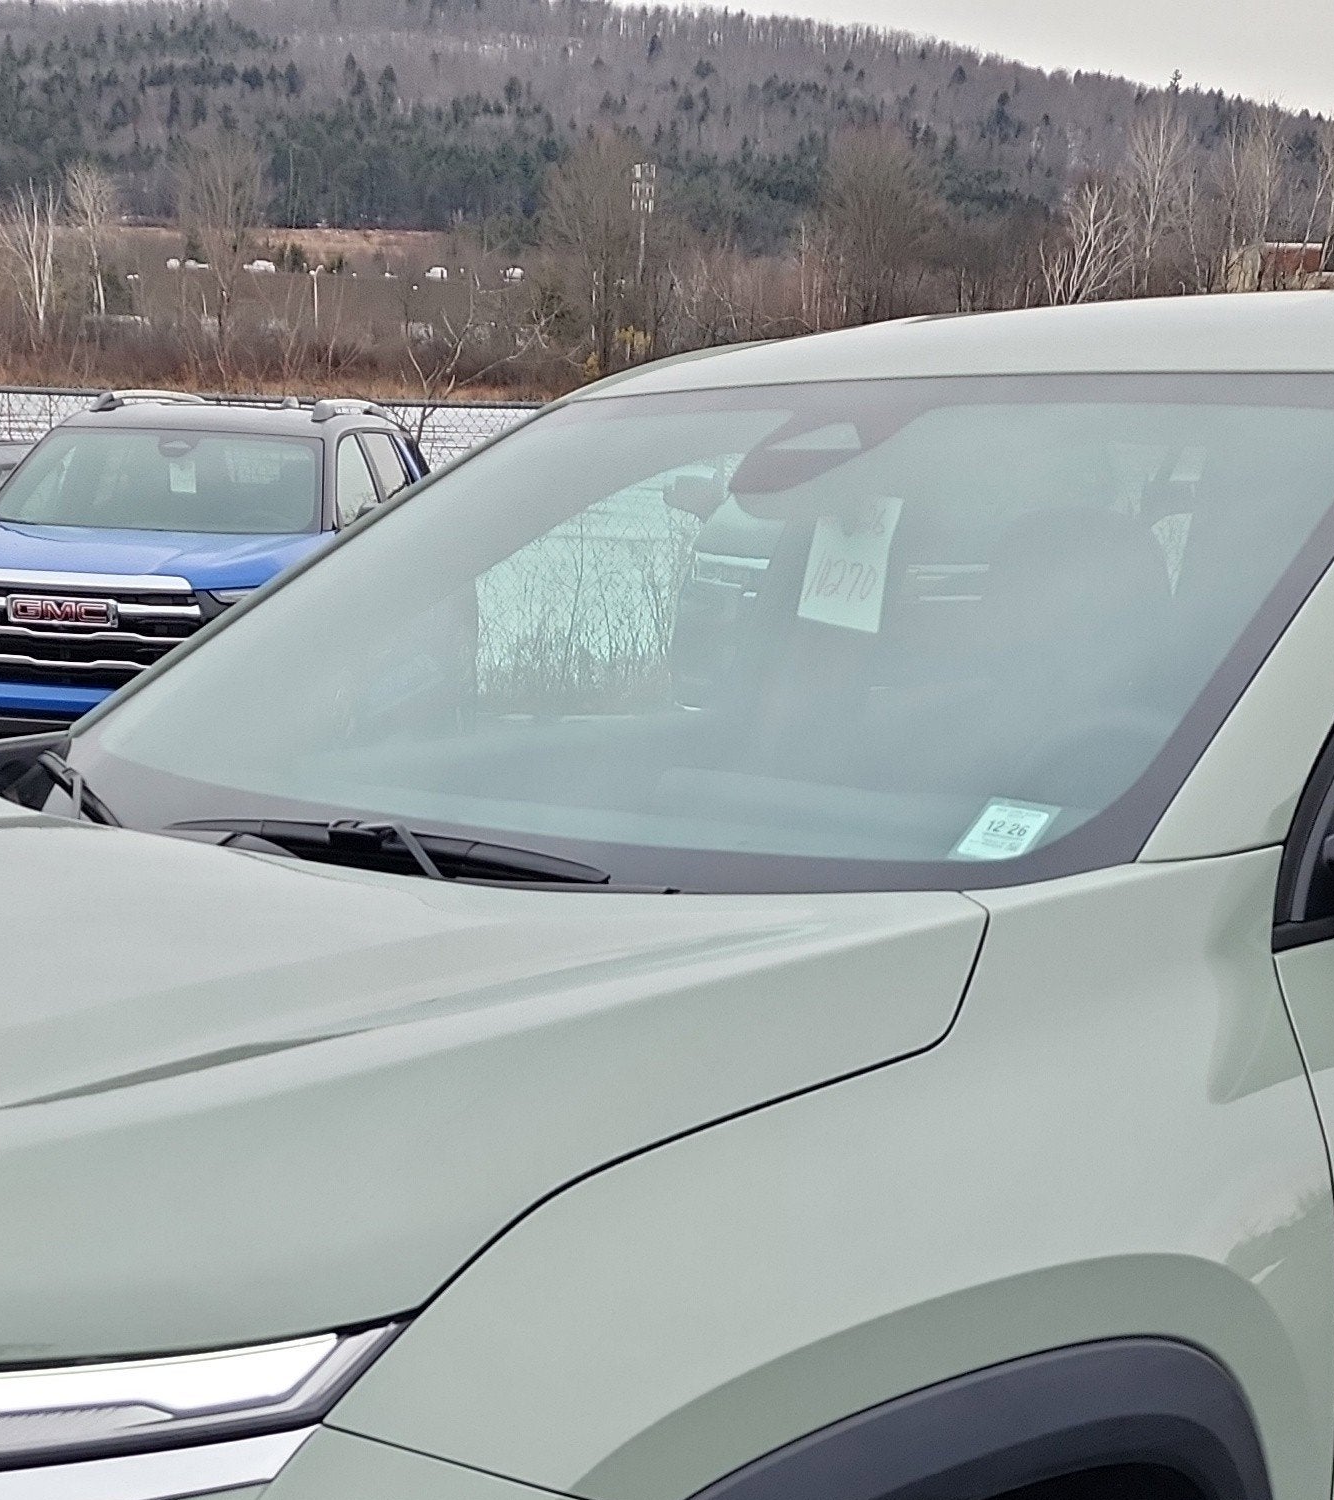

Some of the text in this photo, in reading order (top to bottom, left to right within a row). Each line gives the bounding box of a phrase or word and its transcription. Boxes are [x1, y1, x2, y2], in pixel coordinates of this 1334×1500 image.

[12, 598, 109, 623] GMC
[986, 820, 1006, 833] 12
[1007, 823, 1030, 838] 26
